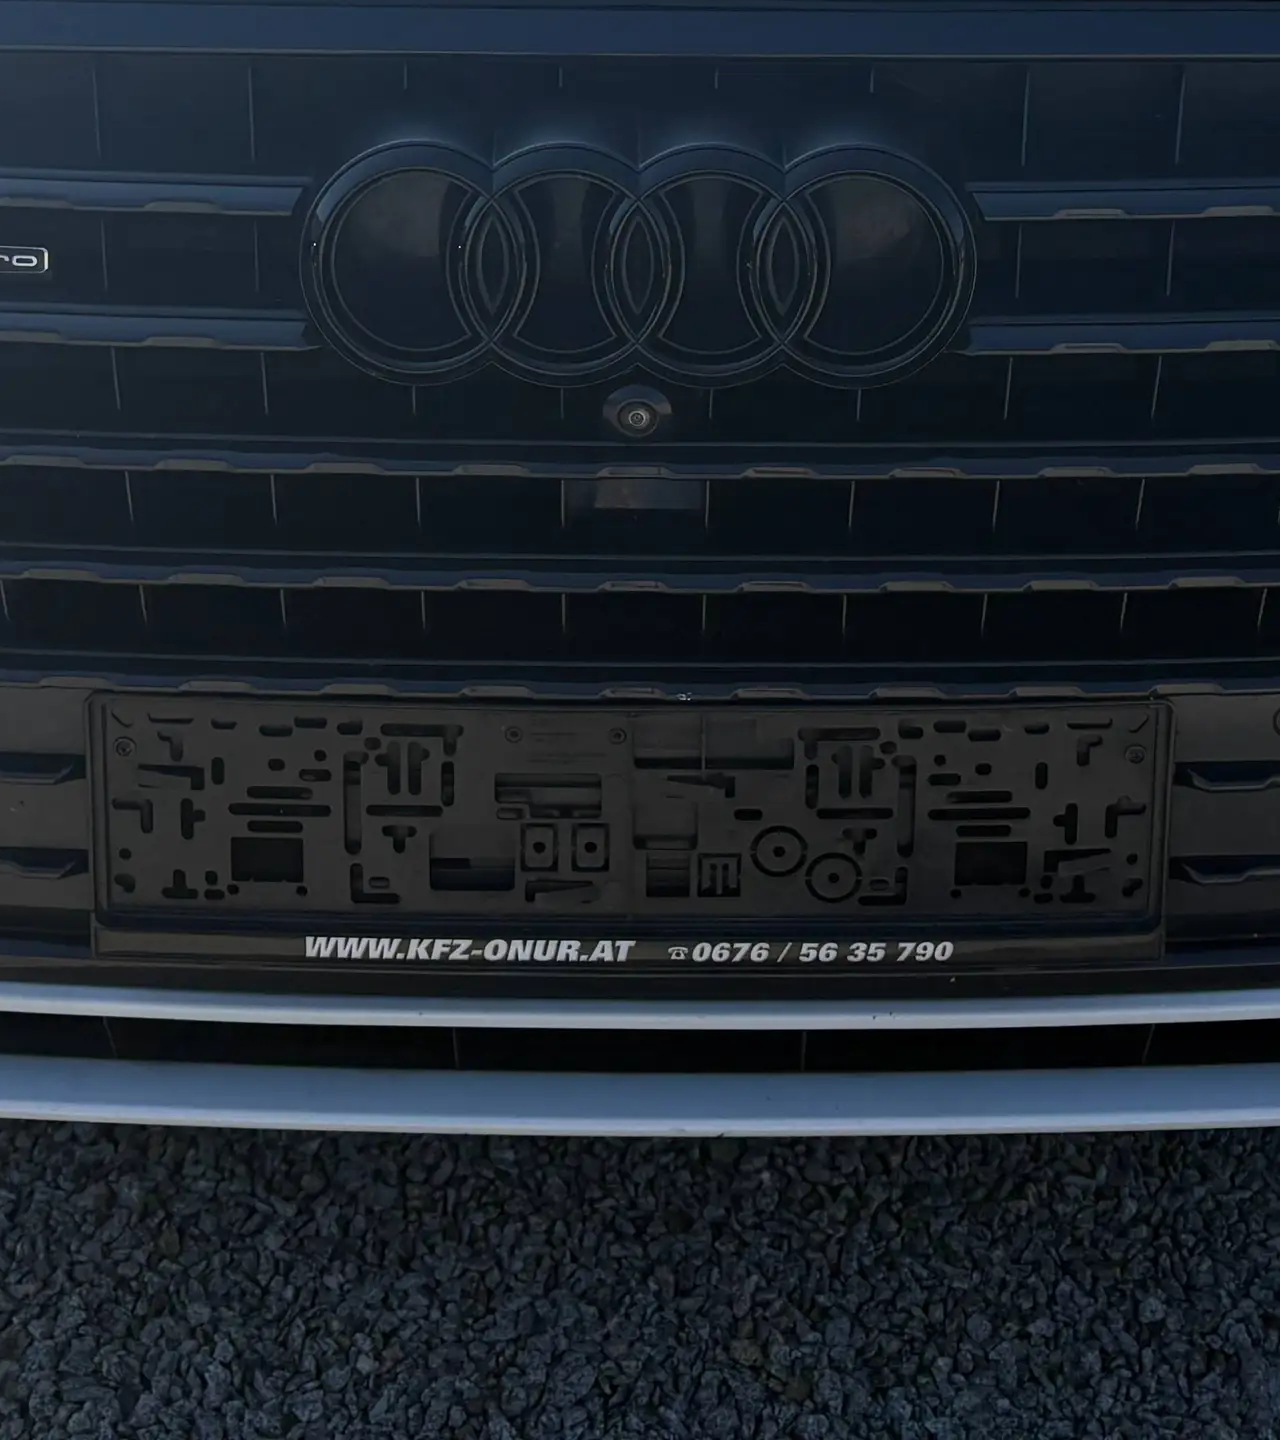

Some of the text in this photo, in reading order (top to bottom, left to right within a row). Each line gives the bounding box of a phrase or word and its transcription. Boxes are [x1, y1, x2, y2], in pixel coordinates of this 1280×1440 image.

[304, 936, 955, 963] WWW.KFZ-ONUR.AT 0676 / 56 35 790
